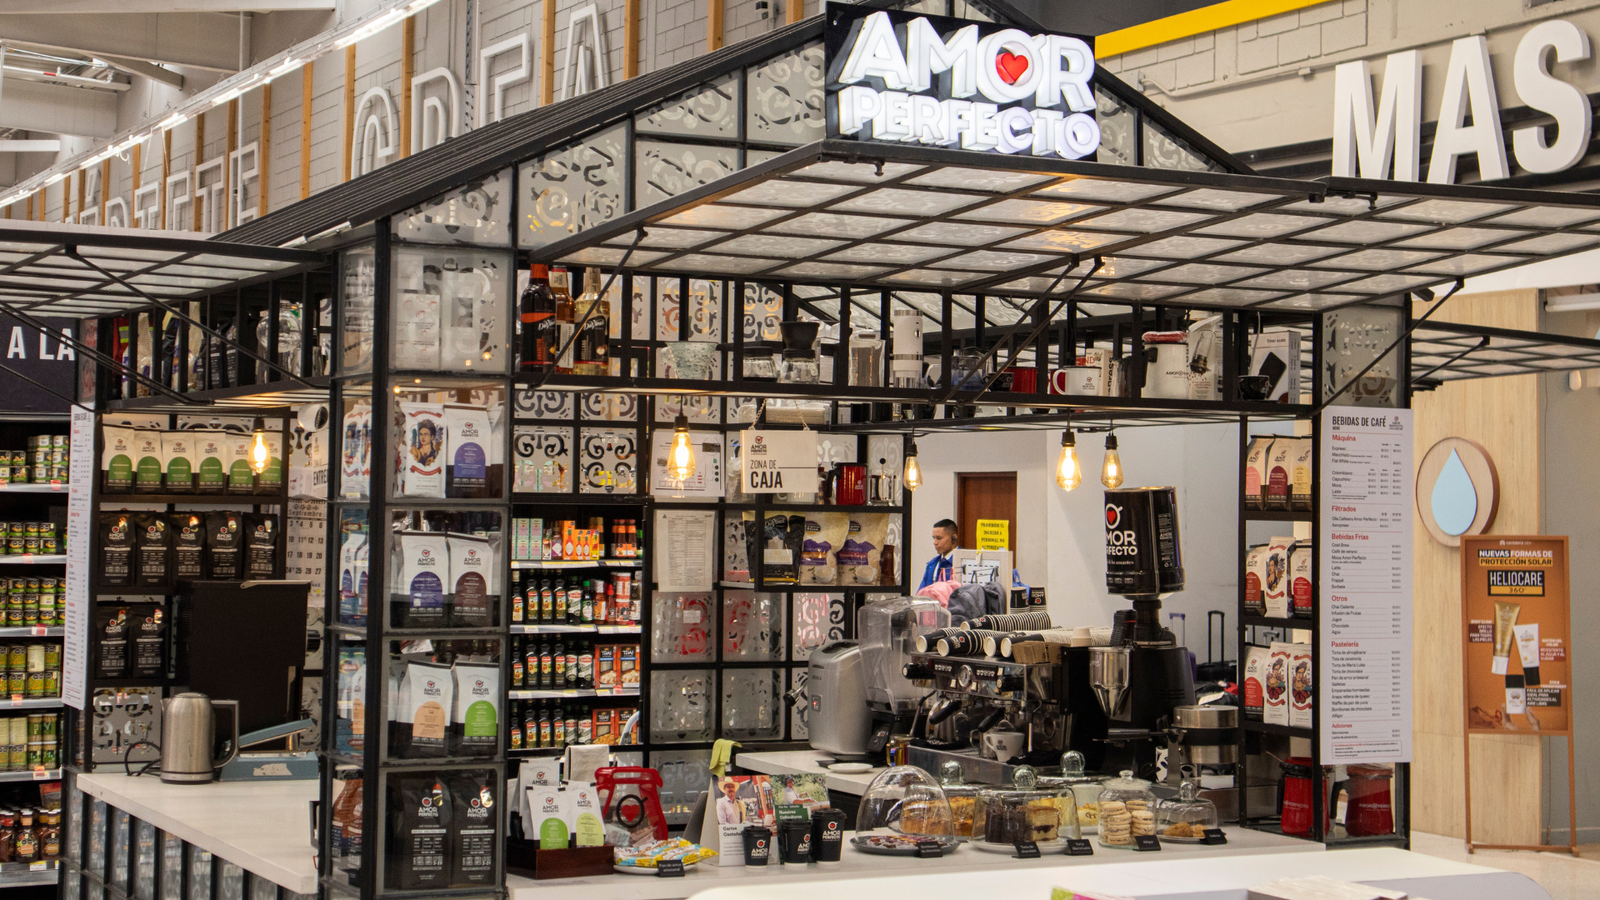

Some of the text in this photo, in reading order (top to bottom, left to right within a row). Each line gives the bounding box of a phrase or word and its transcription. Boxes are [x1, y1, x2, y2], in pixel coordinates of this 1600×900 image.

[838, 11, 1097, 112] AMOR
[1331, 19, 1592, 184] MAS
[838, 85, 1100, 160] PERFECTO
[7, 326, 75, 361] A LA
[1332, 415, 1360, 426] BEBIDAS
[1361, 416, 1370, 427] DE
[1371, 416, 1387, 428] CAFÉ
[750, 460, 777, 470] ZONA DE
[750, 471, 783, 488] CAJA
[1106, 546, 1138, 556] FECTO
[1511, 550, 1542, 558] FORMAS
[1490, 571, 1543, 586] HELIOCARE
